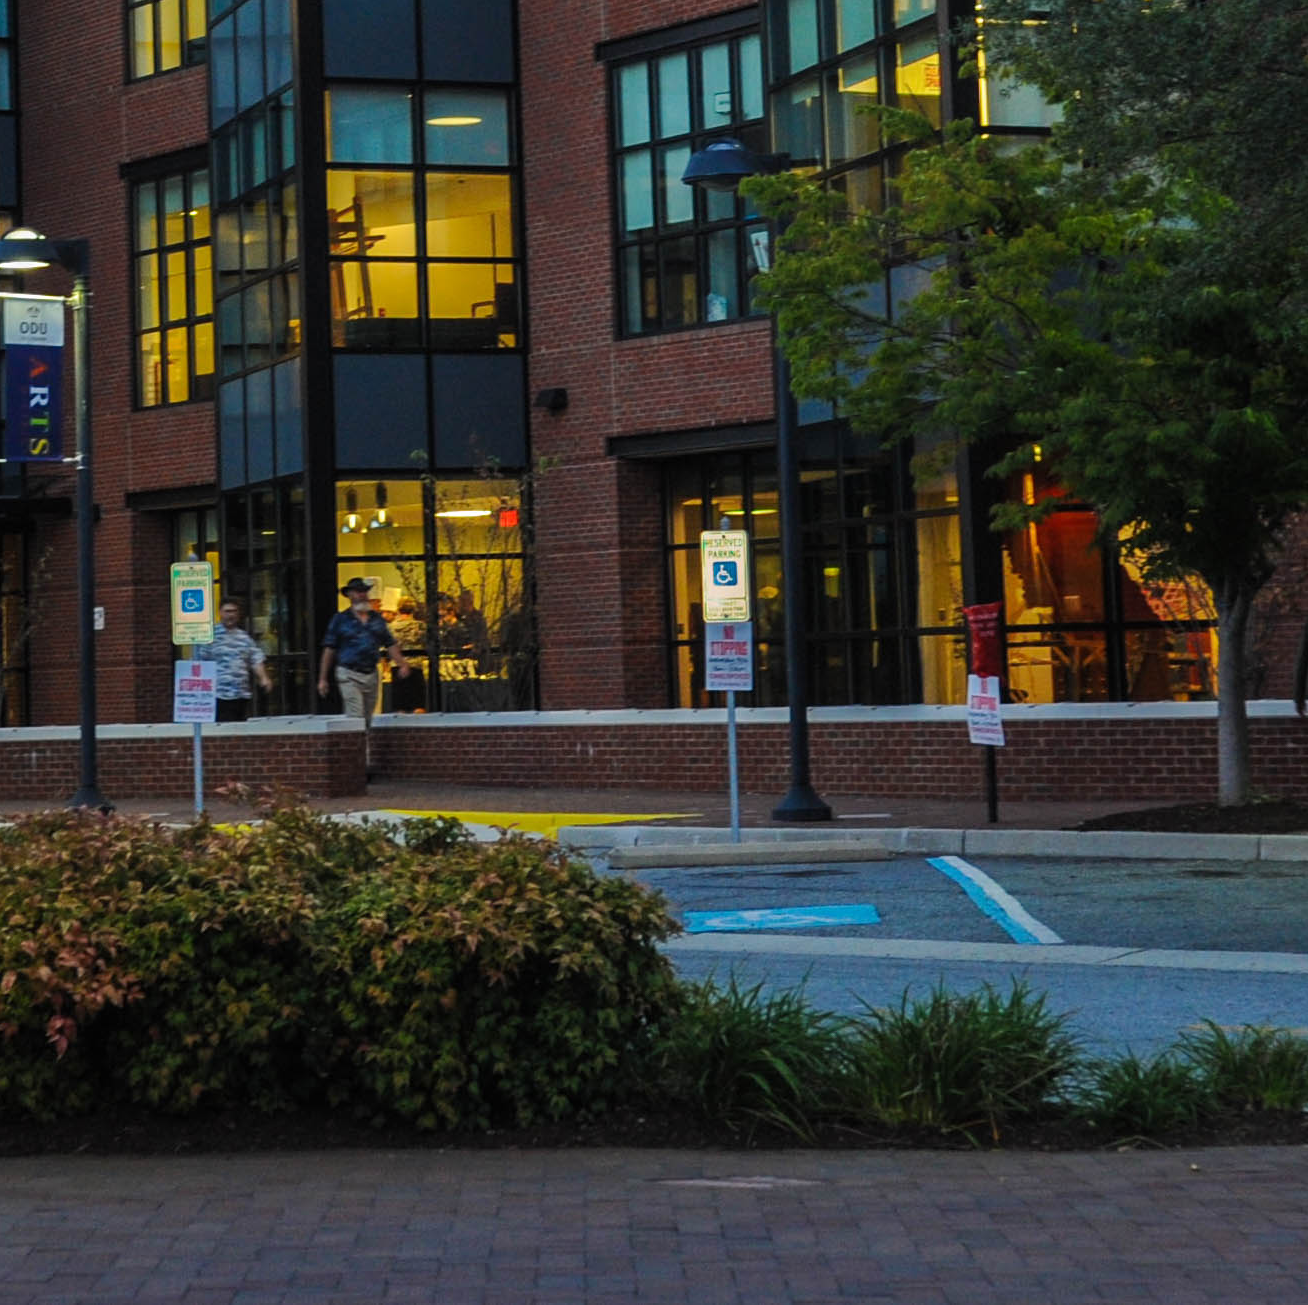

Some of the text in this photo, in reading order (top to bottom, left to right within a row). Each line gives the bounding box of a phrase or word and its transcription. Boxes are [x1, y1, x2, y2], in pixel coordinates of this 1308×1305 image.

[20, 321, 47, 335] ODU
[29, 360, 50, 456] ARTS
[705, 538, 742, 547] RESERVED
[708, 549, 742, 559] PARKING
[173, 568, 210, 577] ESERVED
